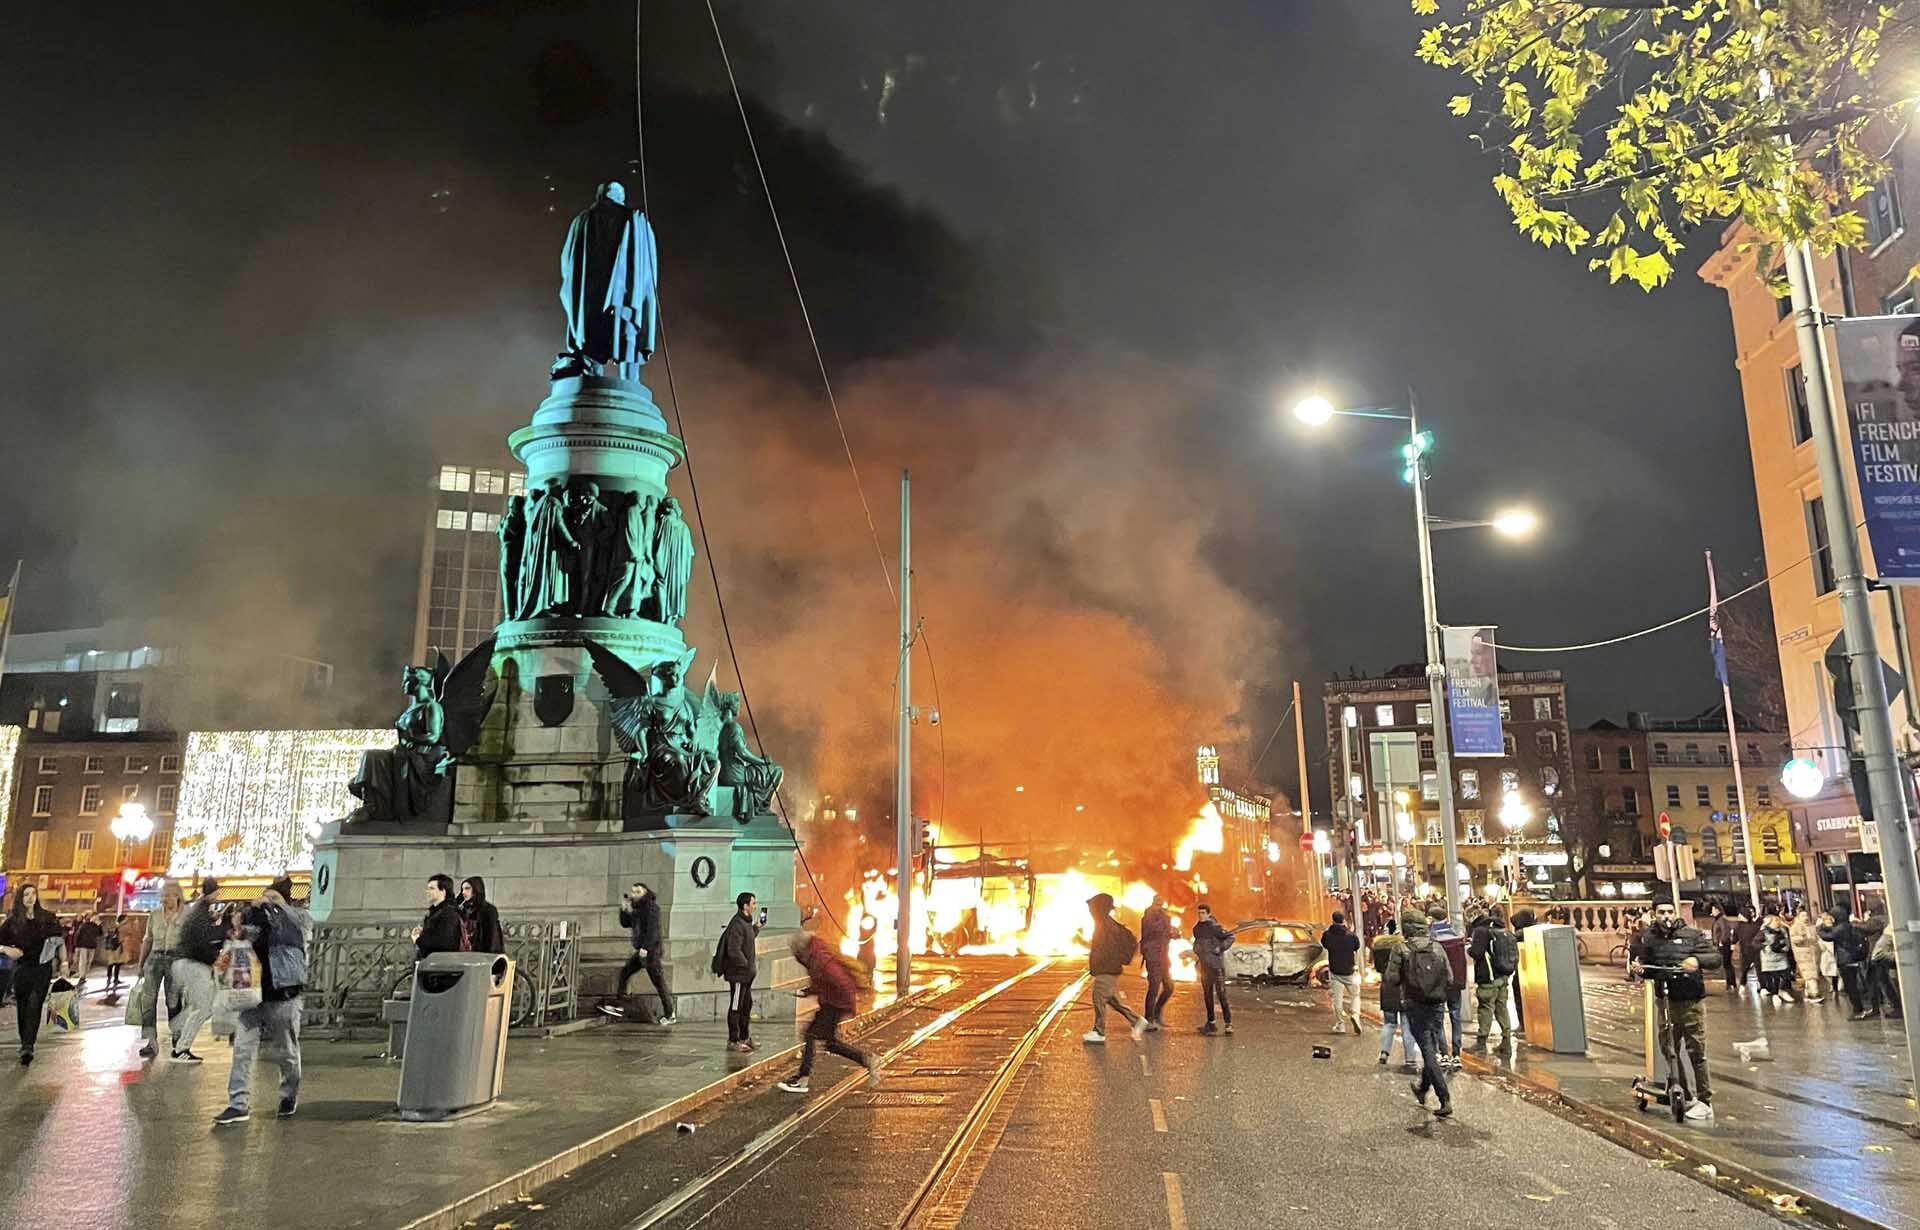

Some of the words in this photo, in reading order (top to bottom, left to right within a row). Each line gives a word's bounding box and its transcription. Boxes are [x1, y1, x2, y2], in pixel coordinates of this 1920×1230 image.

[1855, 402, 1876, 420] IFI
[1858, 421, 1920, 441] FRENCH
[1861, 443, 1900, 462] FILM
[1864, 463, 1920, 483] FESTIV
[1452, 688, 1470, 697] FILM
[1453, 697, 1488, 708] FESTIVAL
